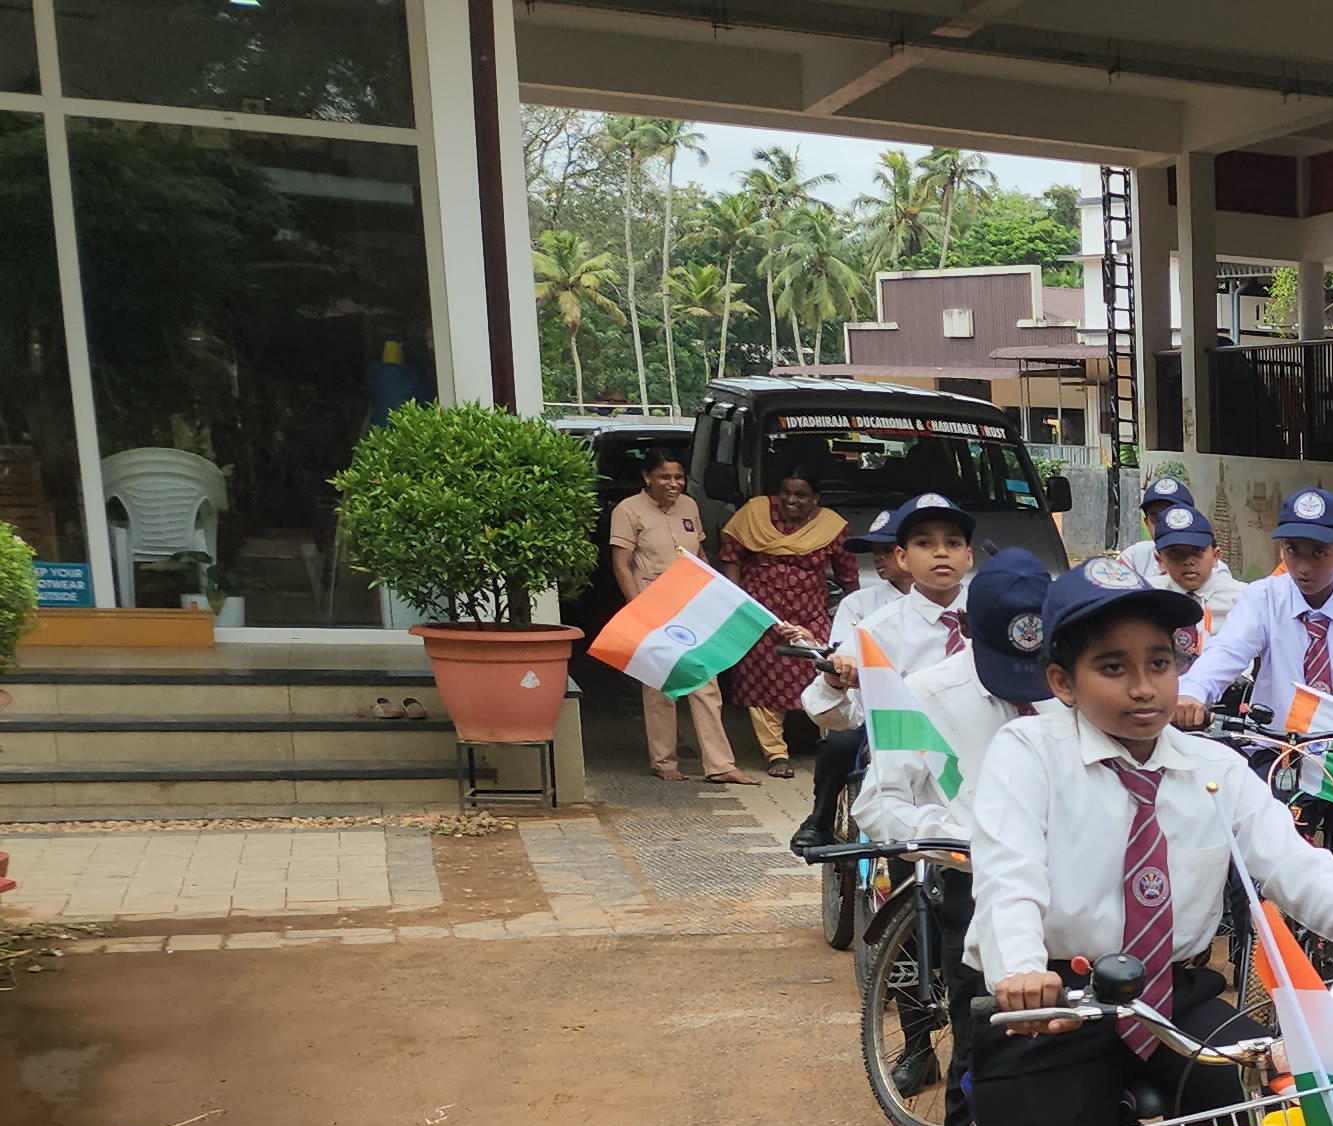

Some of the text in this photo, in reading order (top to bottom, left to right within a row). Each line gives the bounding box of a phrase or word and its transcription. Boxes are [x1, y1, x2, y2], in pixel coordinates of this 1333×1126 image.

[778, 415, 1006, 440] VIDYADHIRAJA EDUCATIONAL & CHARITABLE TRUST
[49, 568, 83, 578] YOUR
[37, 580, 85, 590] OTWEAR
